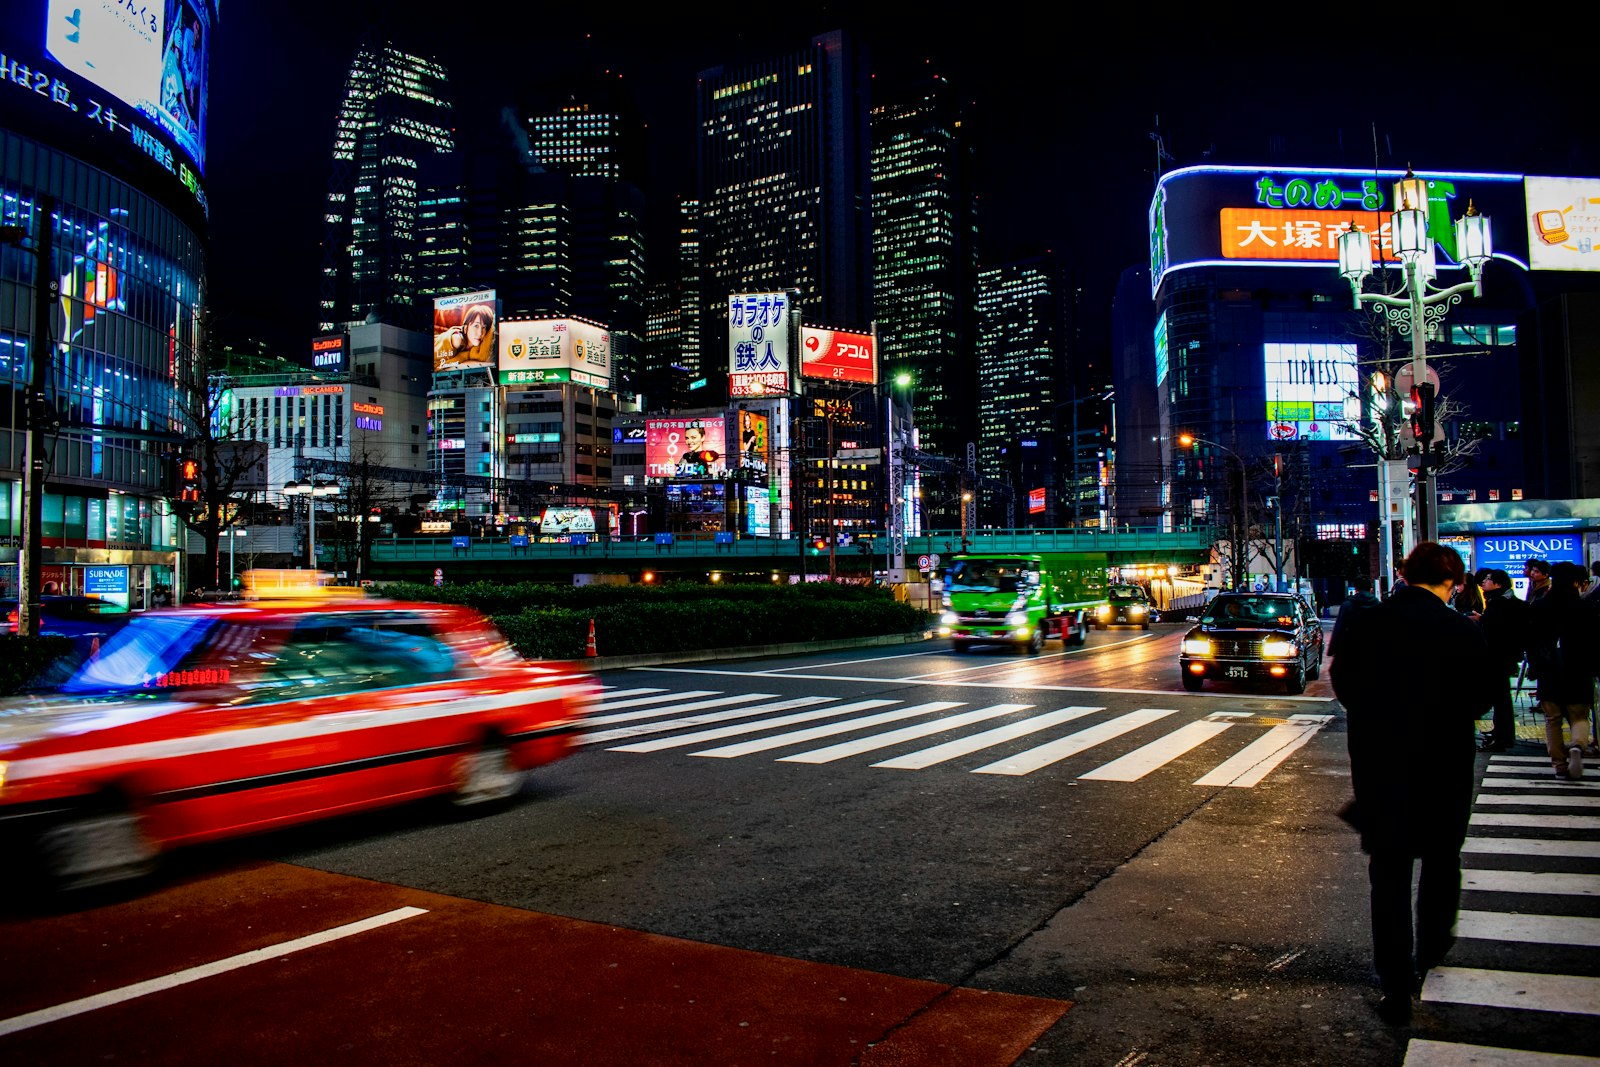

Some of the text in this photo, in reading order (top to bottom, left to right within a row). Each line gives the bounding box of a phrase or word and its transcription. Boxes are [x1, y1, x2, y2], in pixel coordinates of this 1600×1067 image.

[1256, 177, 1385, 210] たのめーる
[731, 295, 785, 327] カラオケ
[529, 335, 561, 345] シェーン
[752, 325, 764, 344] の
[529, 345, 561, 356] 英会話
[735, 340, 781, 371] 鉄人
[836, 343, 869, 360] アコム
[314, 352, 341, 367] ODAKYU
[507, 371, 545, 382] 新宿本校
[832, 367, 845, 378] 2F
[1287, 348, 1338, 395] TIPNESS
[274, 386, 300, 397] ODAKYU
[315, 385, 344, 394] CAMERA
[353, 402, 384, 415] ビックカメラ
[356, 416, 382, 431] ODAKYU
[1483, 538, 1574, 553] SUBNADE
[89, 569, 125, 578] SUBNADE
